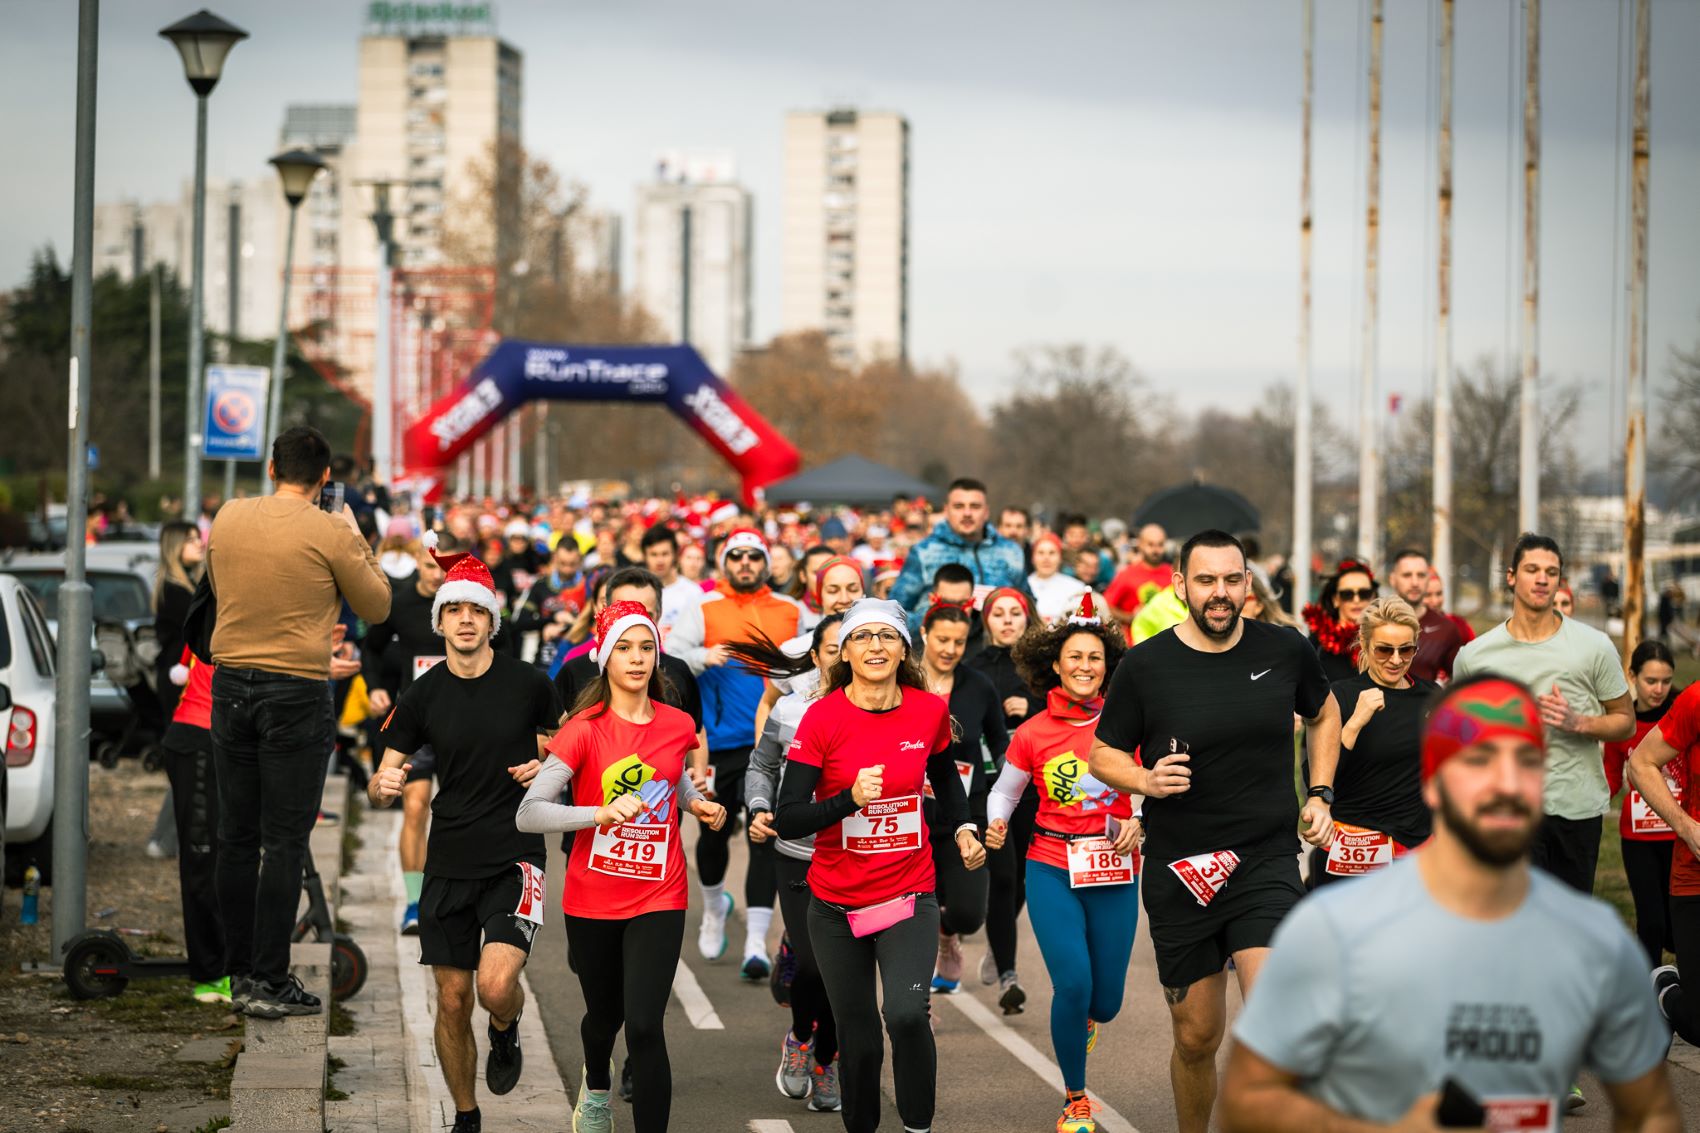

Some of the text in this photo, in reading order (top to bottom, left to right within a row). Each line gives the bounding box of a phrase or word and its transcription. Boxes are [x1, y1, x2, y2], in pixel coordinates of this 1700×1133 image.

[525, 359, 669, 383] RunTrace
[867, 801, 909, 810] RESOLUTION
[621, 826, 660, 836] RESOLUTION
[868, 817, 899, 835] 75
[1344, 834, 1381, 843] RESOLUTION
[609, 840, 656, 862] 419
[1339, 847, 1380, 862] 367
[1085, 852, 1122, 870] 186
[533, 874, 542, 902] 70
[1446, 1028, 1542, 1063] PROUD
